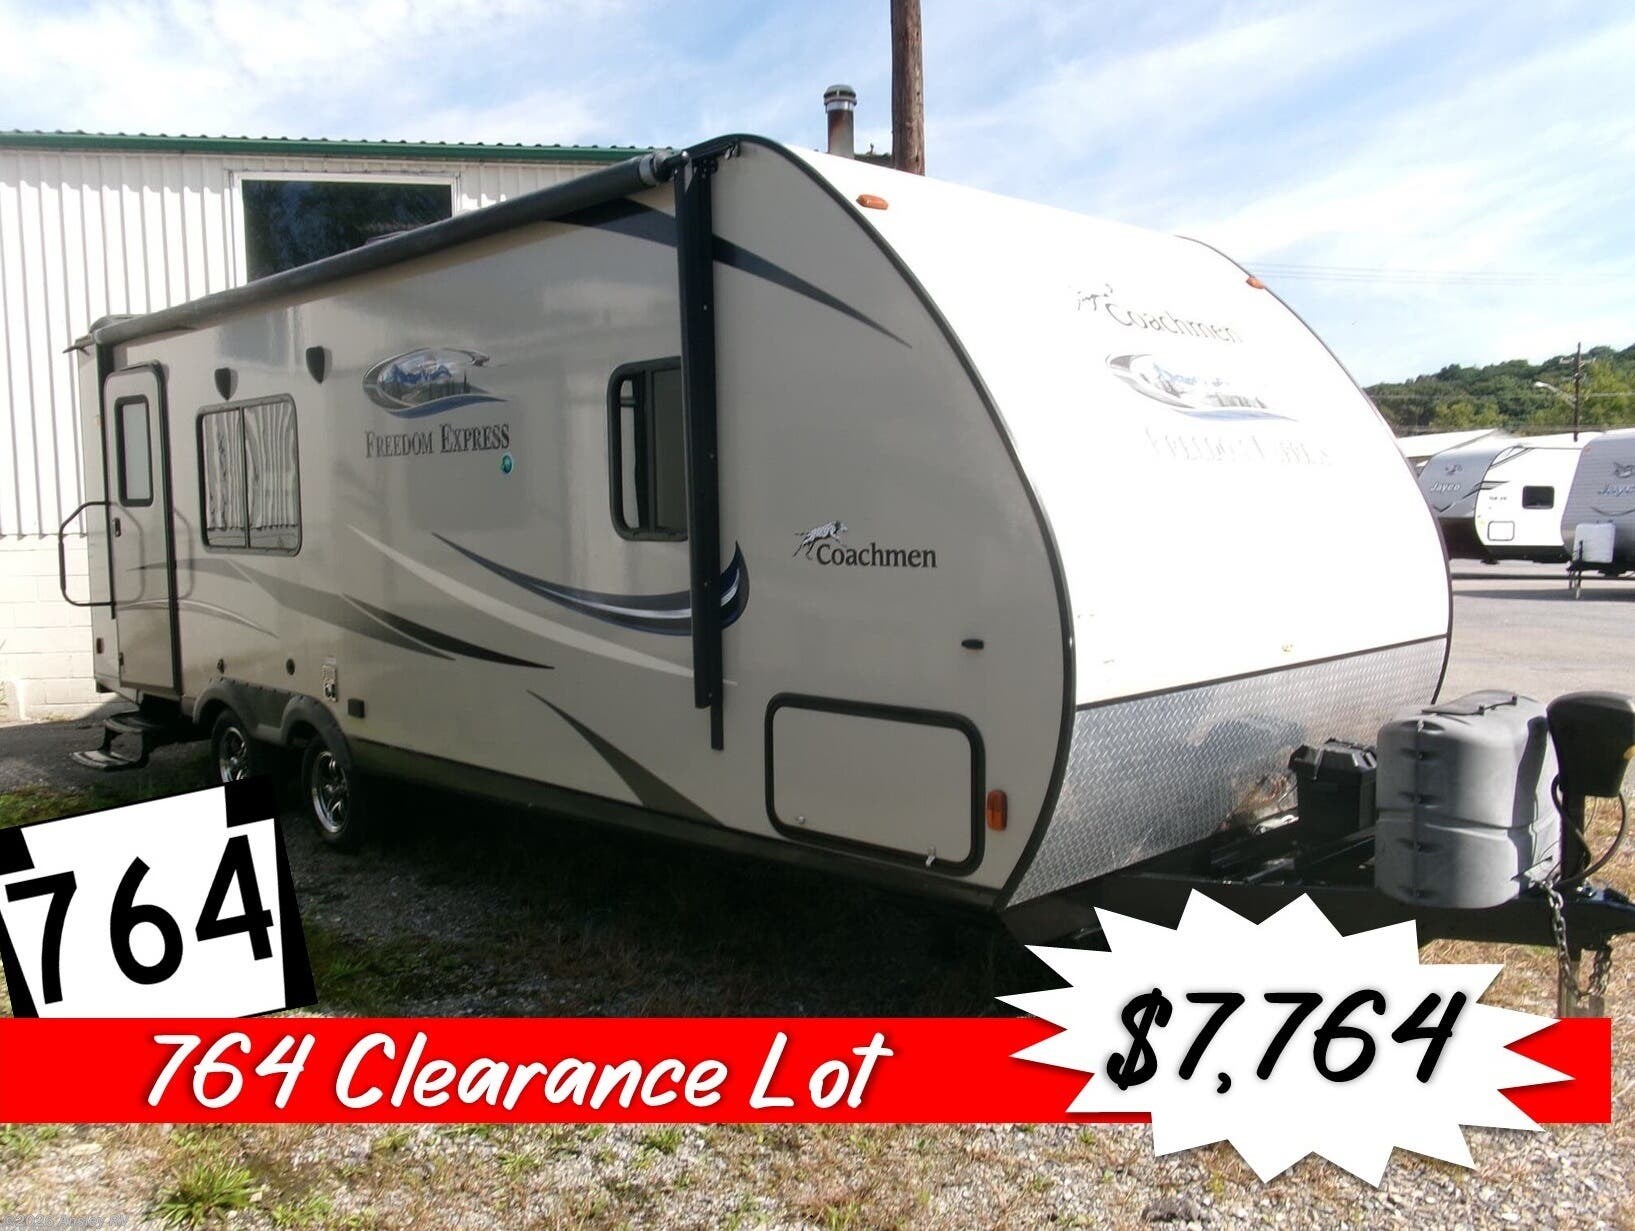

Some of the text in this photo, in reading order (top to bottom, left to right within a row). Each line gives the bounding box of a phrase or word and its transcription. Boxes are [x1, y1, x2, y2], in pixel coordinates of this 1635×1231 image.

[1104, 303, 1243, 343] Coachmen
[364, 423, 510, 458] FREEDOM EXPRESS
[816, 542, 938, 568] Coachmen
